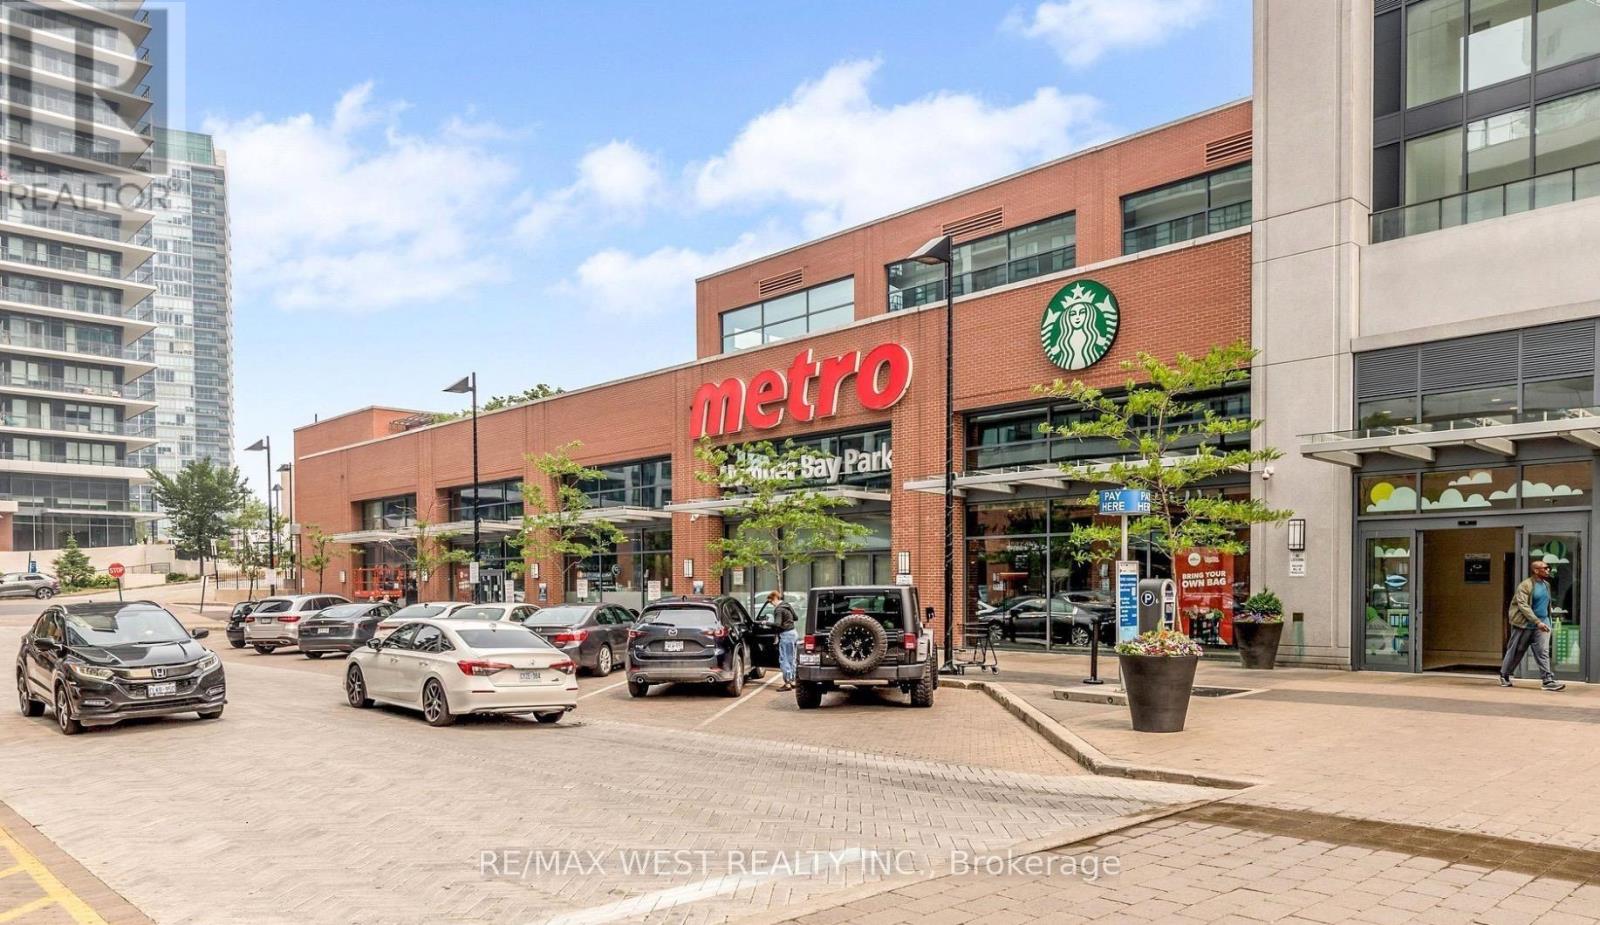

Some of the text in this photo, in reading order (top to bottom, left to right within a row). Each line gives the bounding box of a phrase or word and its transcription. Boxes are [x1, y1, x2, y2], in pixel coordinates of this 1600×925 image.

[689, 342, 913, 440] metro
[800, 454, 842, 483] Bay
[844, 442, 892, 474] Park
[1104, 491, 1121, 501] PAY
[1102, 501, 1125, 511] HERE
[1182, 570, 1226, 580] BRING YOUR
[1182, 577, 1226, 589] OWN BAG
